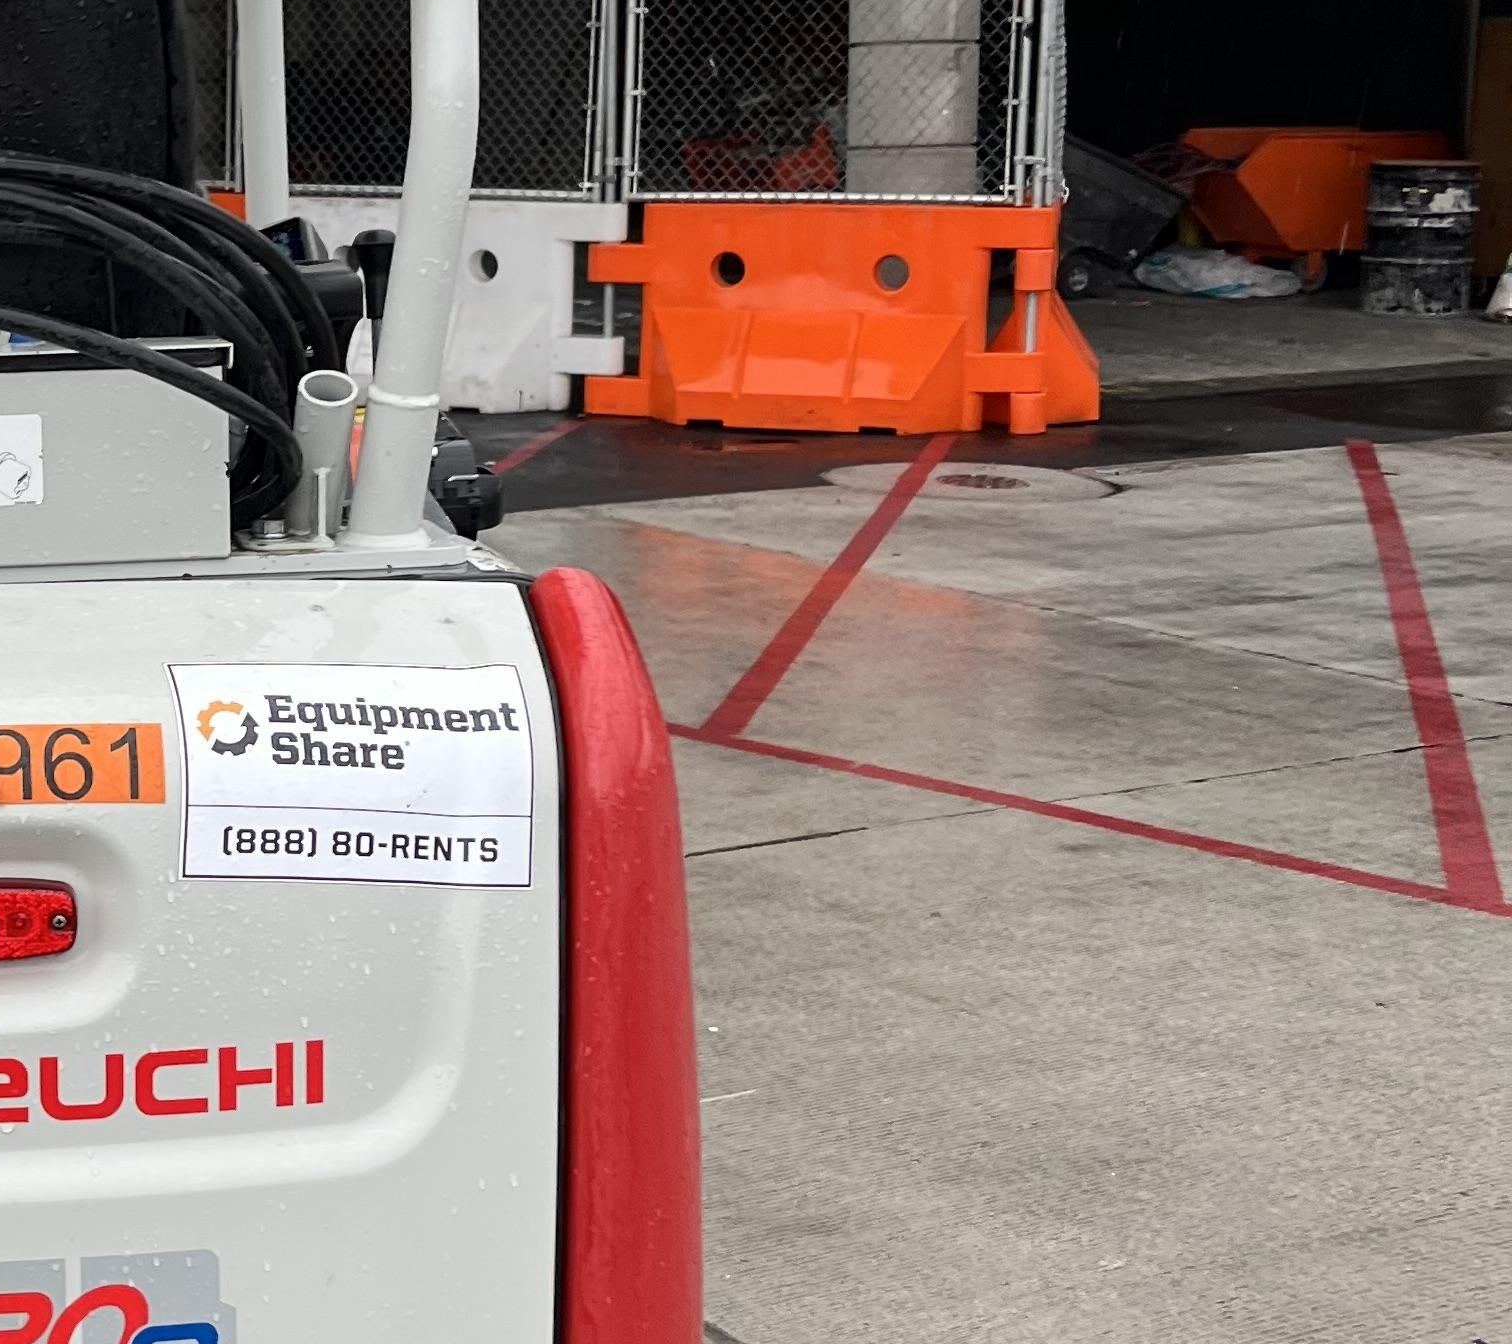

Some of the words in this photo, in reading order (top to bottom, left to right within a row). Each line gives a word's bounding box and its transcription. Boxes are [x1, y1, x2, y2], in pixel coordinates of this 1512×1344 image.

[265, 694, 519, 736] Equipment
[271, 731, 408, 771] Share
[222, 827, 318, 859] (888)
[331, 828, 500, 864] 80-RENTS
